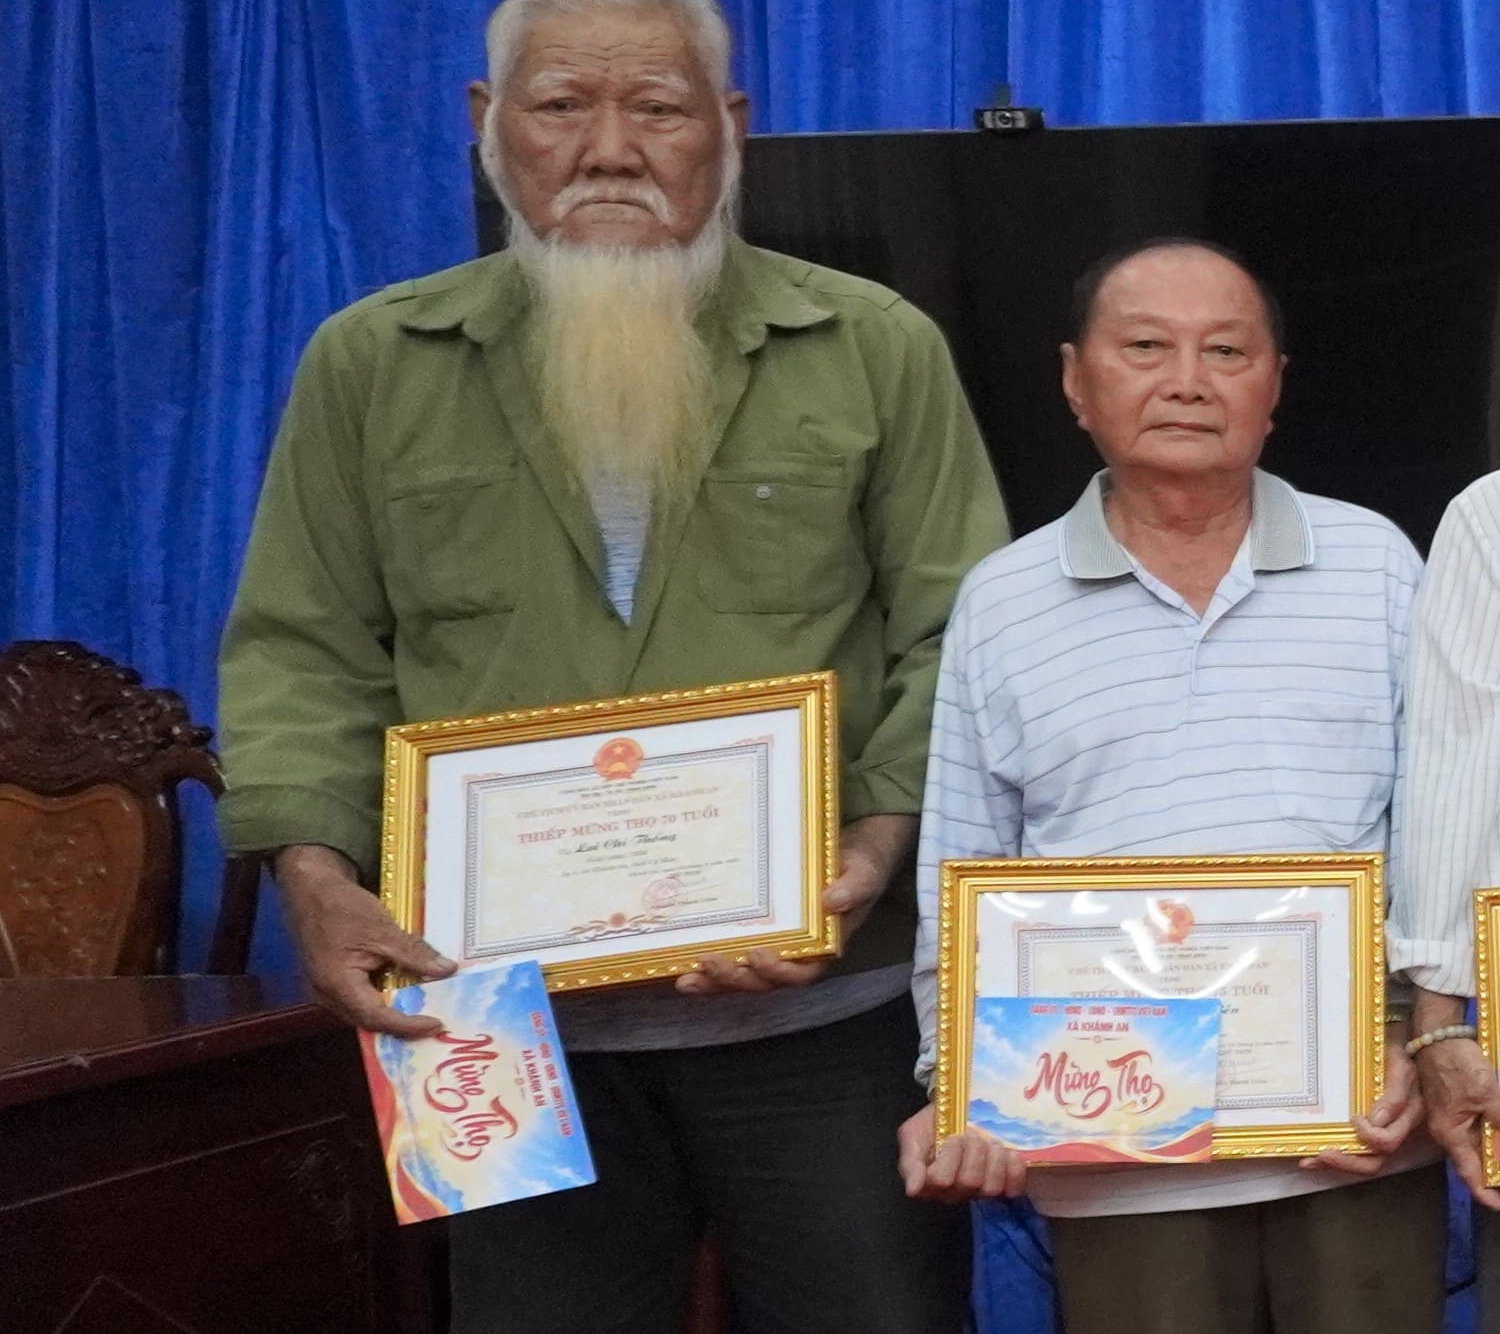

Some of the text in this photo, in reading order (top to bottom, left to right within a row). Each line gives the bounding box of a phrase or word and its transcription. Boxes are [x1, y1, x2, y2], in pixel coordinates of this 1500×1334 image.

[424, 1031, 518, 1162] Mừng Thọ
[1023, 1050, 1167, 1120] Mừng Thọ
